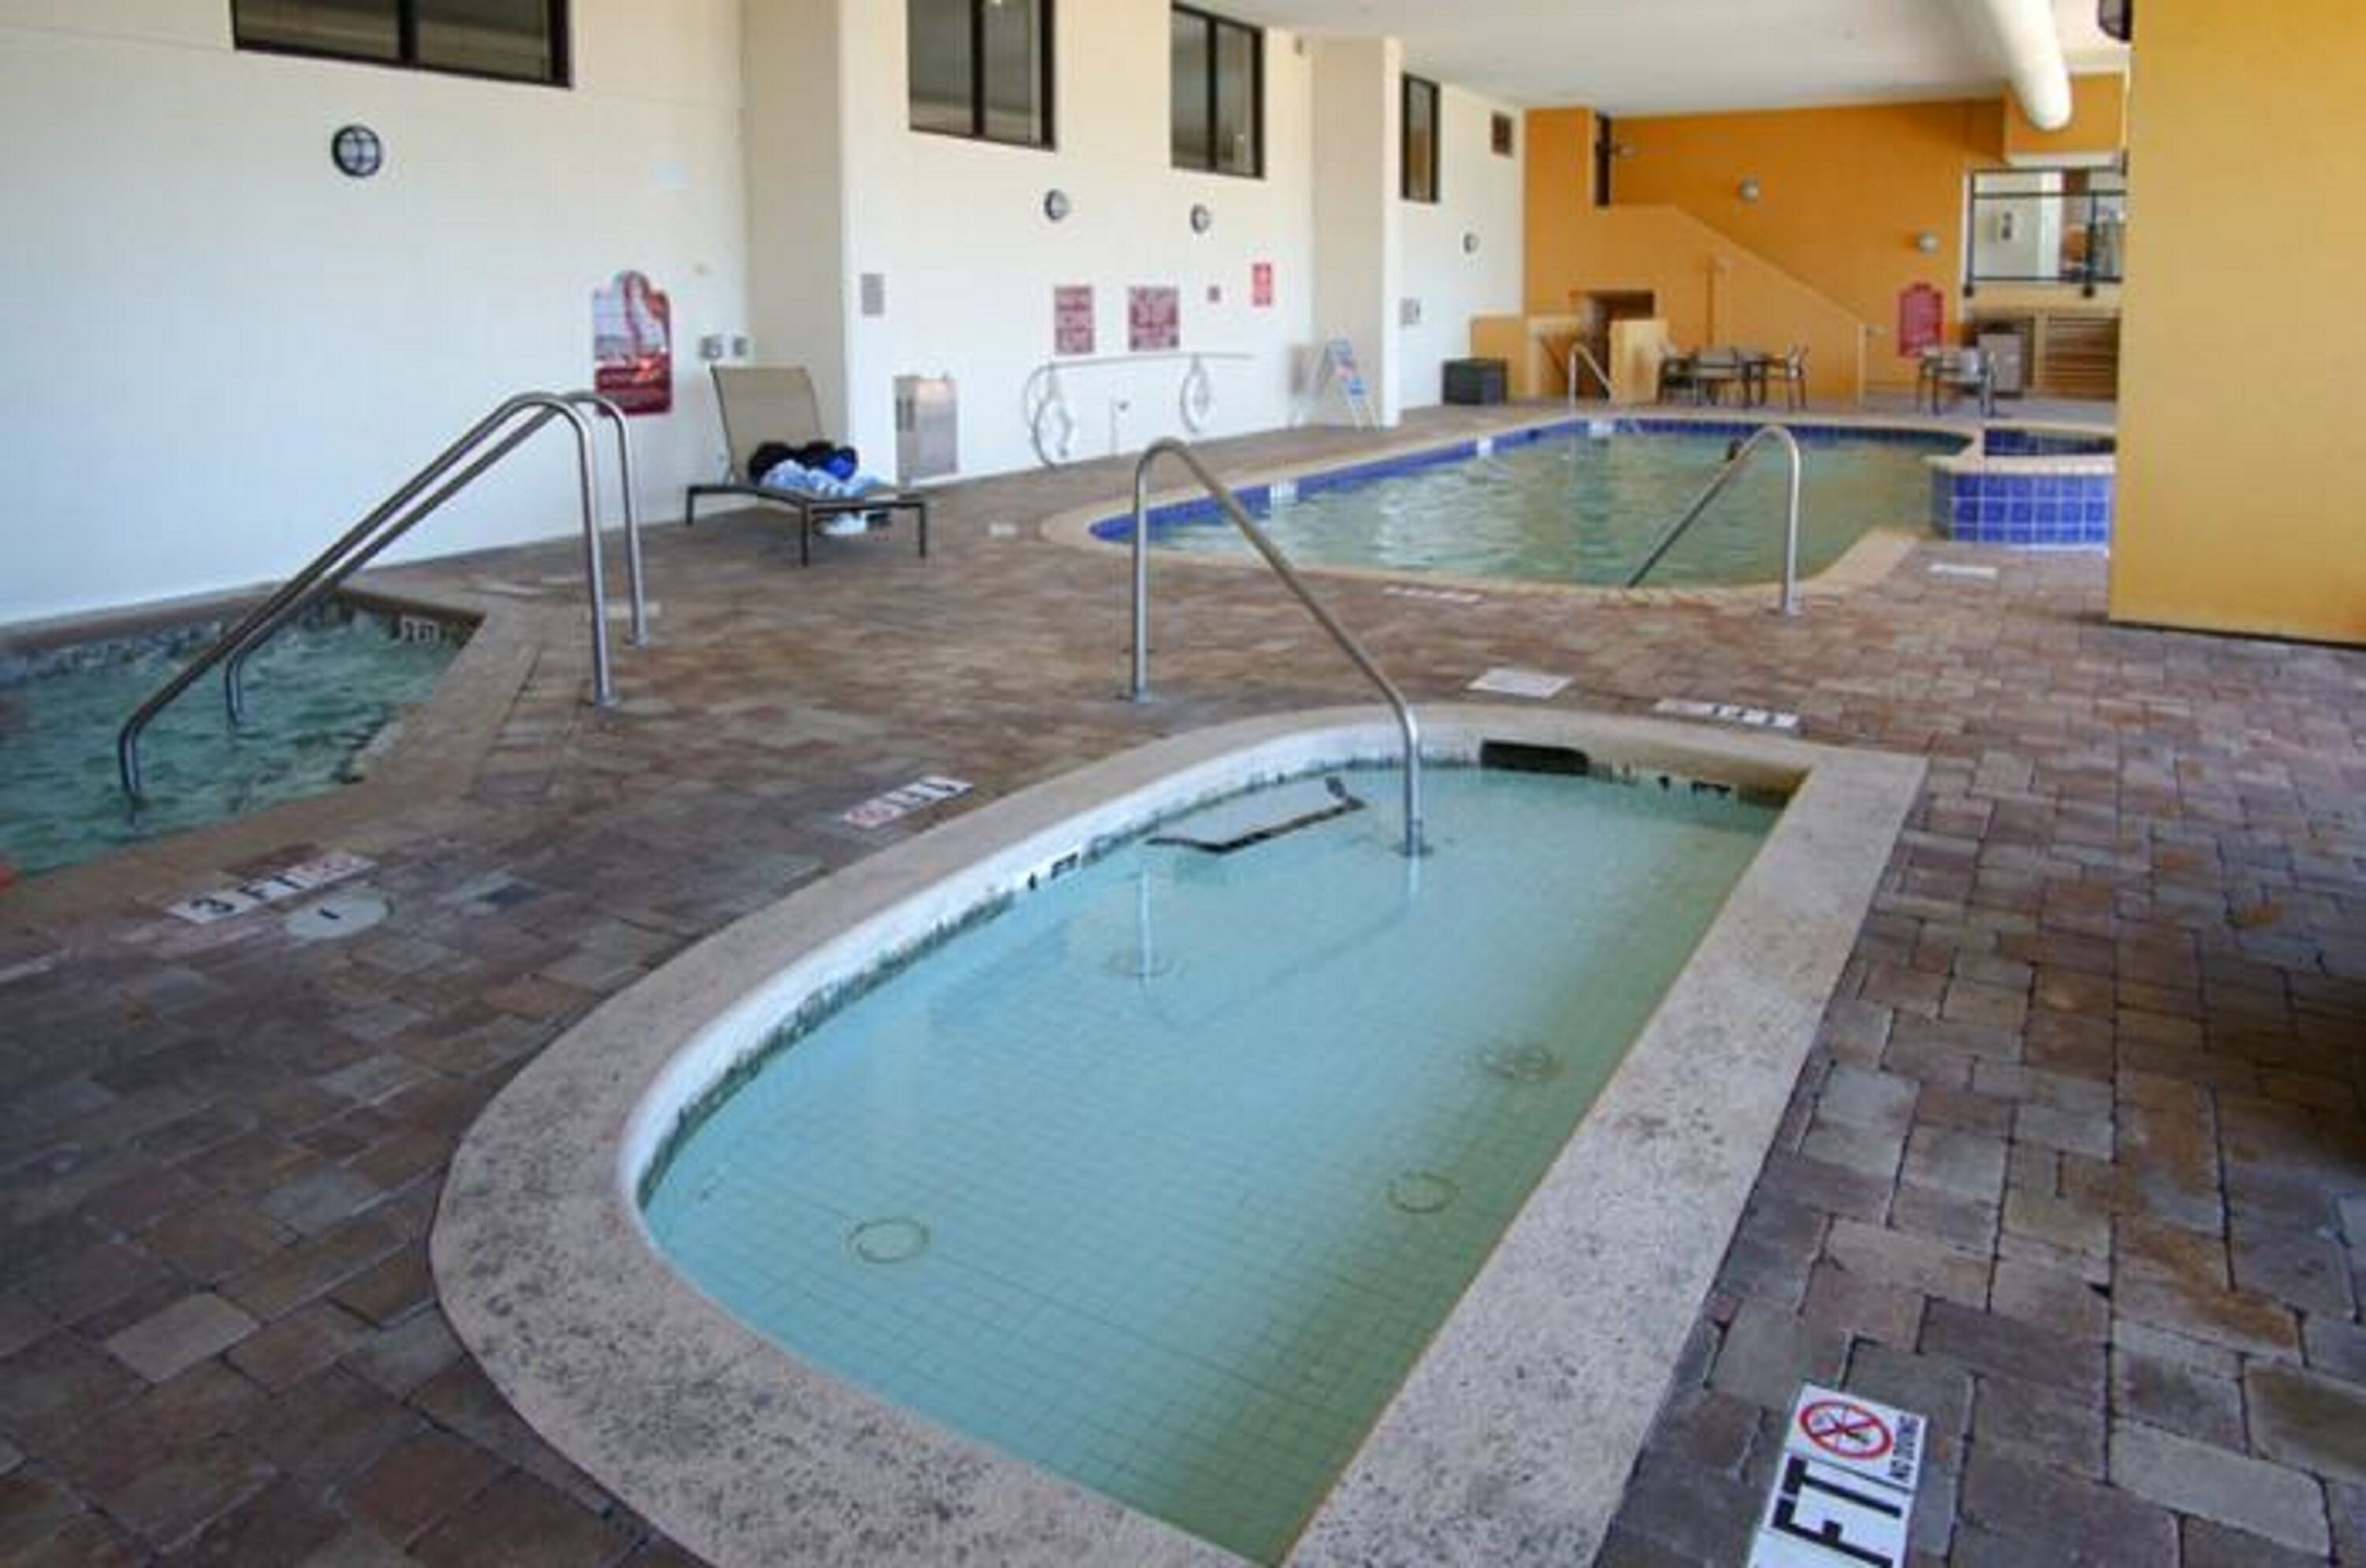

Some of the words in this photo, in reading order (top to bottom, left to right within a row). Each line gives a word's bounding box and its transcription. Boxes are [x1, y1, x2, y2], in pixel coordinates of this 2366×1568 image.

[190, 897, 235, 914] 3
[237, 874, 305, 902] FT
[1771, 1455, 1903, 1568] FT
